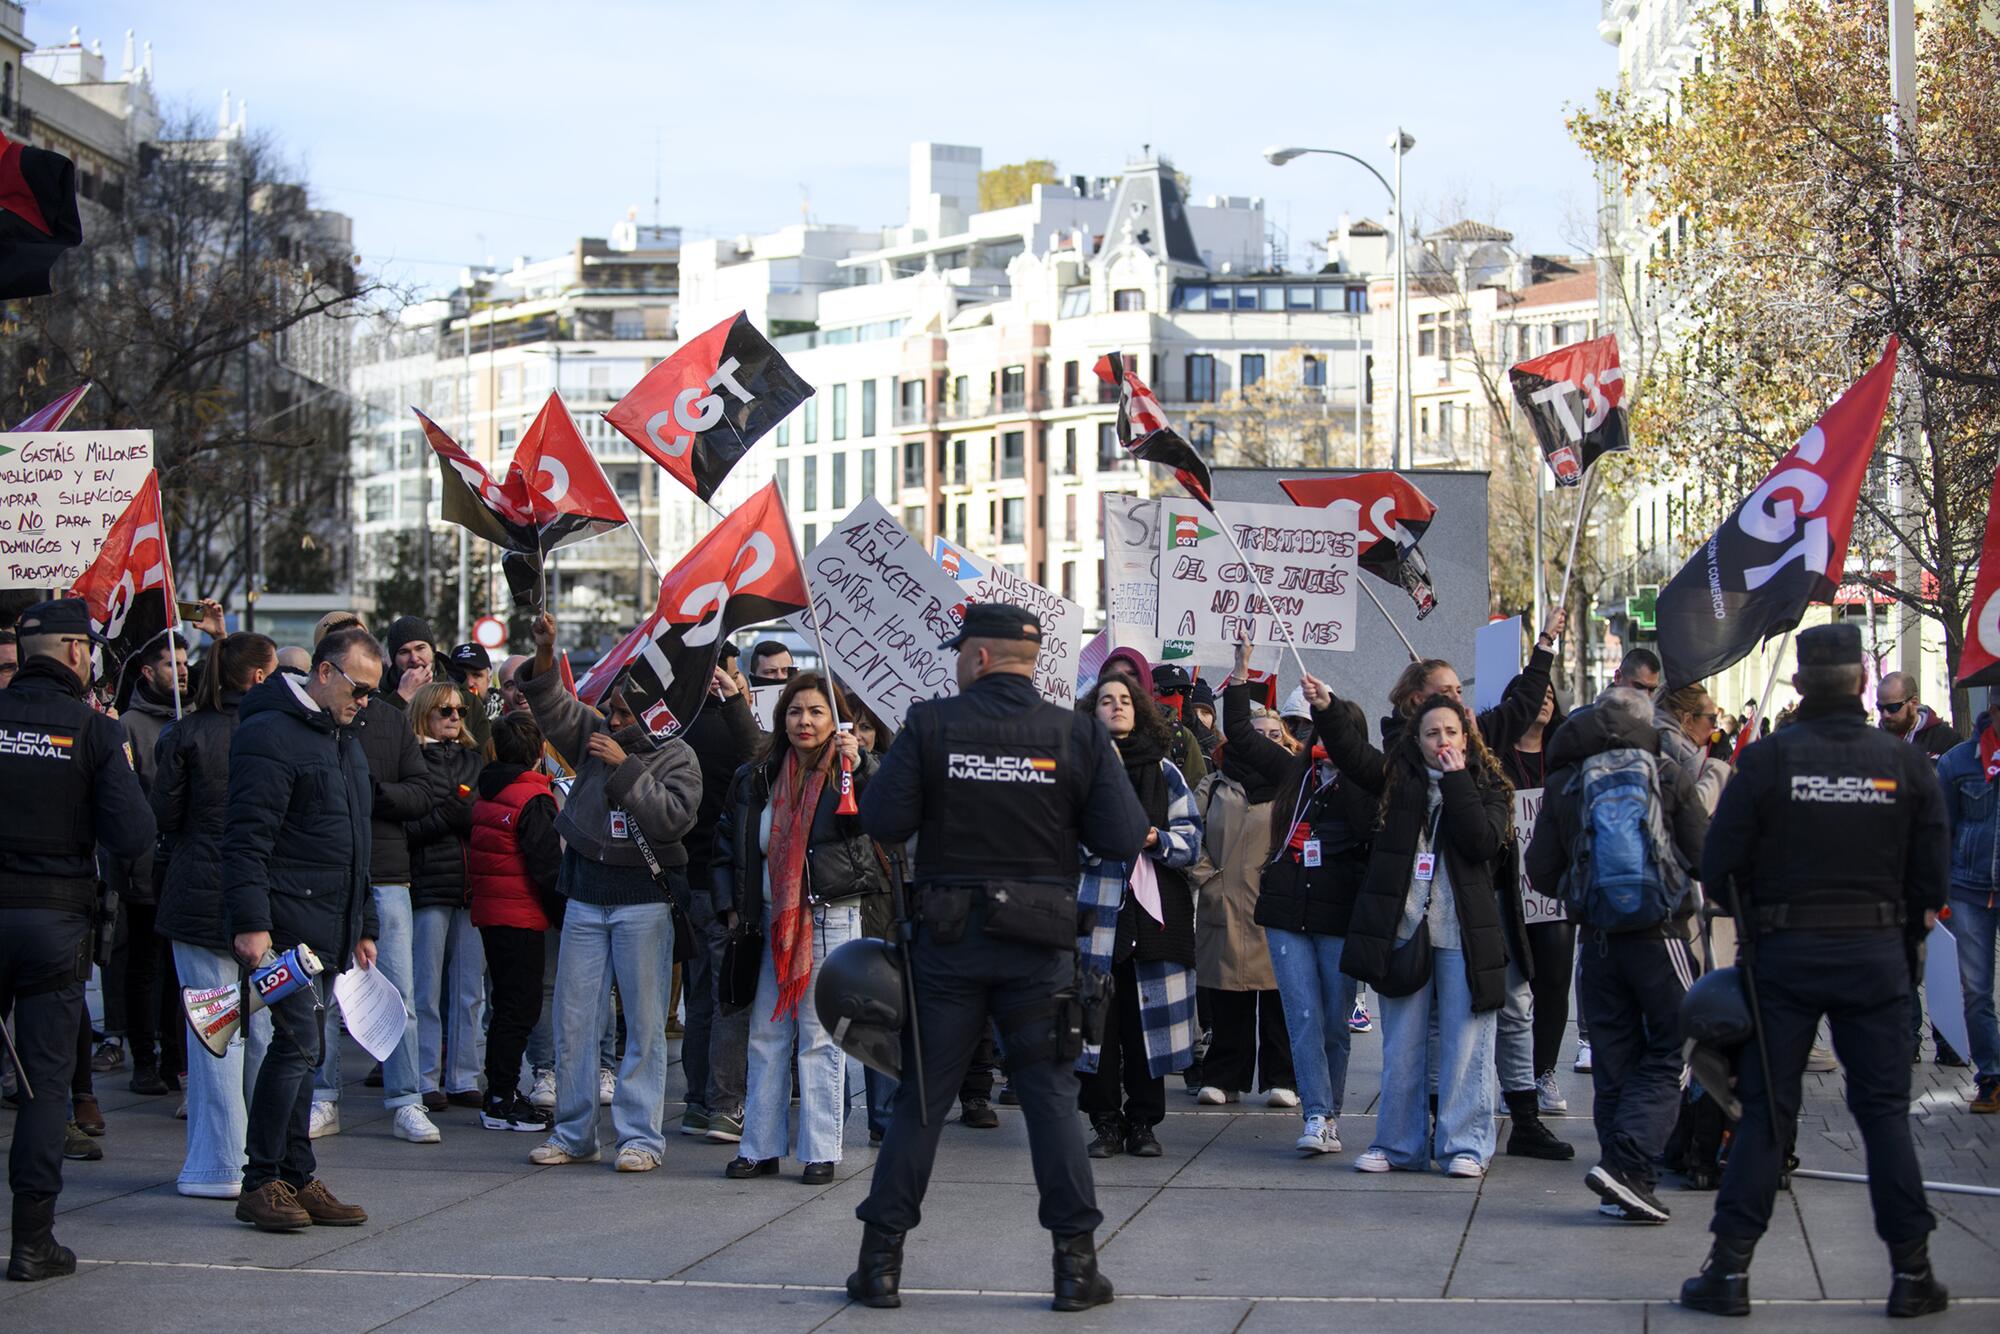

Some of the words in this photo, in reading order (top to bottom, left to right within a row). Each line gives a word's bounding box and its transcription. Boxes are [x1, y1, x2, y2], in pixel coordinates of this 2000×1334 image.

[645, 356, 755, 457] CGT
[20, 441, 75, 462] GASTÁIS
[86, 441, 148, 462] MILLONES
[74, 470, 83, 484] Y
[94, 469, 114, 482] EN
[59, 487, 133, 505] SILENCIOS
[19, 511, 43, 531] NO
[56, 514, 91, 529] PARA
[0, 538, 62, 554] DOMINGOS
[71, 540, 81, 554] Y
[872, 518, 909, 550] ECI
[1176, 537, 1197, 547] CGT
[1233, 523, 1356, 558] TRABAJADORES
[8, 562, 80, 580] TRABAJAMOS
[840, 522, 926, 606] ALBACETE
[1172, 555, 1208, 583] DEL
[1218, 562, 1274, 585] CORTE
[1278, 563, 1349, 596] INGLÉS
[991, 566, 1066, 617] NUESTROS
[1211, 589, 1240, 614] NO
[1244, 593, 1304, 616] LLEGAN
[1708, 567, 1726, 620] COMERCIO
[817, 557, 876, 622] CONTRA
[873, 613, 957, 697] HORARIOS
[1178, 610, 1196, 637] A
[1221, 615, 1256, 642] FIN
[1269, 621, 1295, 643] DE
[1302, 621, 1342, 644] MES
[1044, 676, 1072, 702] NIÑA
[949, 753, 1034, 770] POLICIA
[841, 771, 852, 795] CGT
[948, 766, 1056, 784] NACIONAL
[1791, 776, 1875, 791] POLICIA
[1791, 788, 1896, 804] NACIONAL
[639, 841, 657, 866] KORS
[260, 968, 288, 994] CGT
